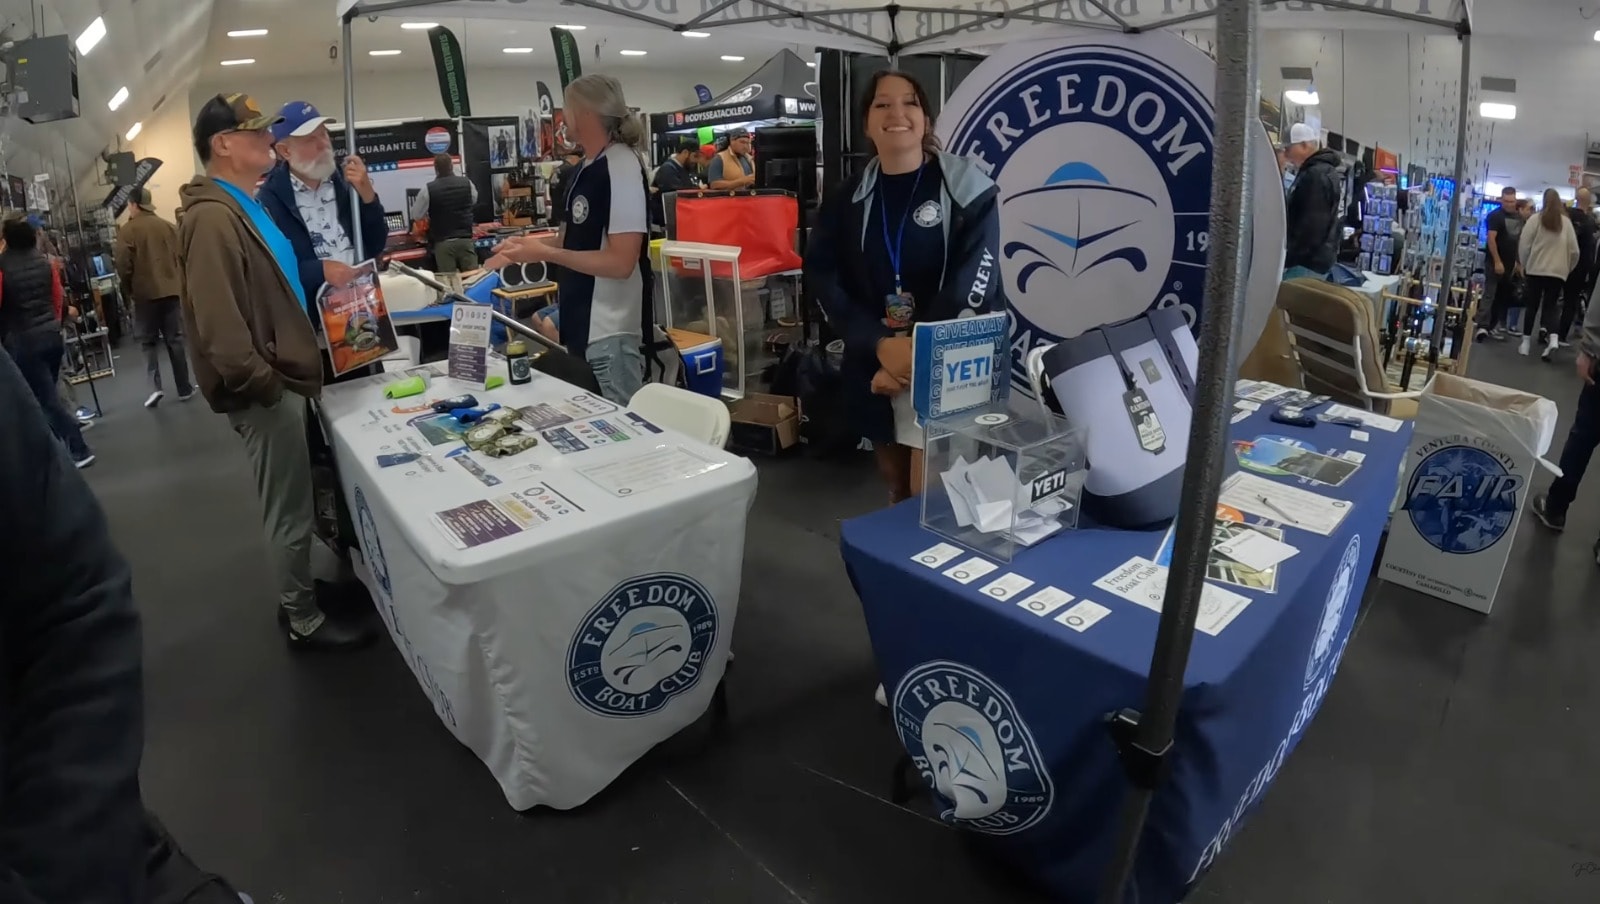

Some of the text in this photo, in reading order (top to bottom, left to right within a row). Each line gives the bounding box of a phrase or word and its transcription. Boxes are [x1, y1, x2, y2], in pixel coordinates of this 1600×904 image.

[965, 74, 1206, 177] FREEDOM
[358, 141, 417, 154] GUARANTEE
[967, 247, 995, 308] CREW
[933, 316, 1007, 342] GIVEAWAY
[946, 356, 991, 383] YETI
[1416, 434, 1518, 471] VENTURA COUNTY
[1034, 471, 1066, 498] YETI
[1411, 473, 1525, 502] FAIR
[1104, 562, 1143, 587] Freedom
[1116, 563, 1159, 594] Boat Club
[583, 585, 696, 648] FREEDOM
[692, 620, 713, 634] 1989
[594, 651, 702, 710] BOAT CLUB
[911, 675, 1031, 773] FREEDOM
